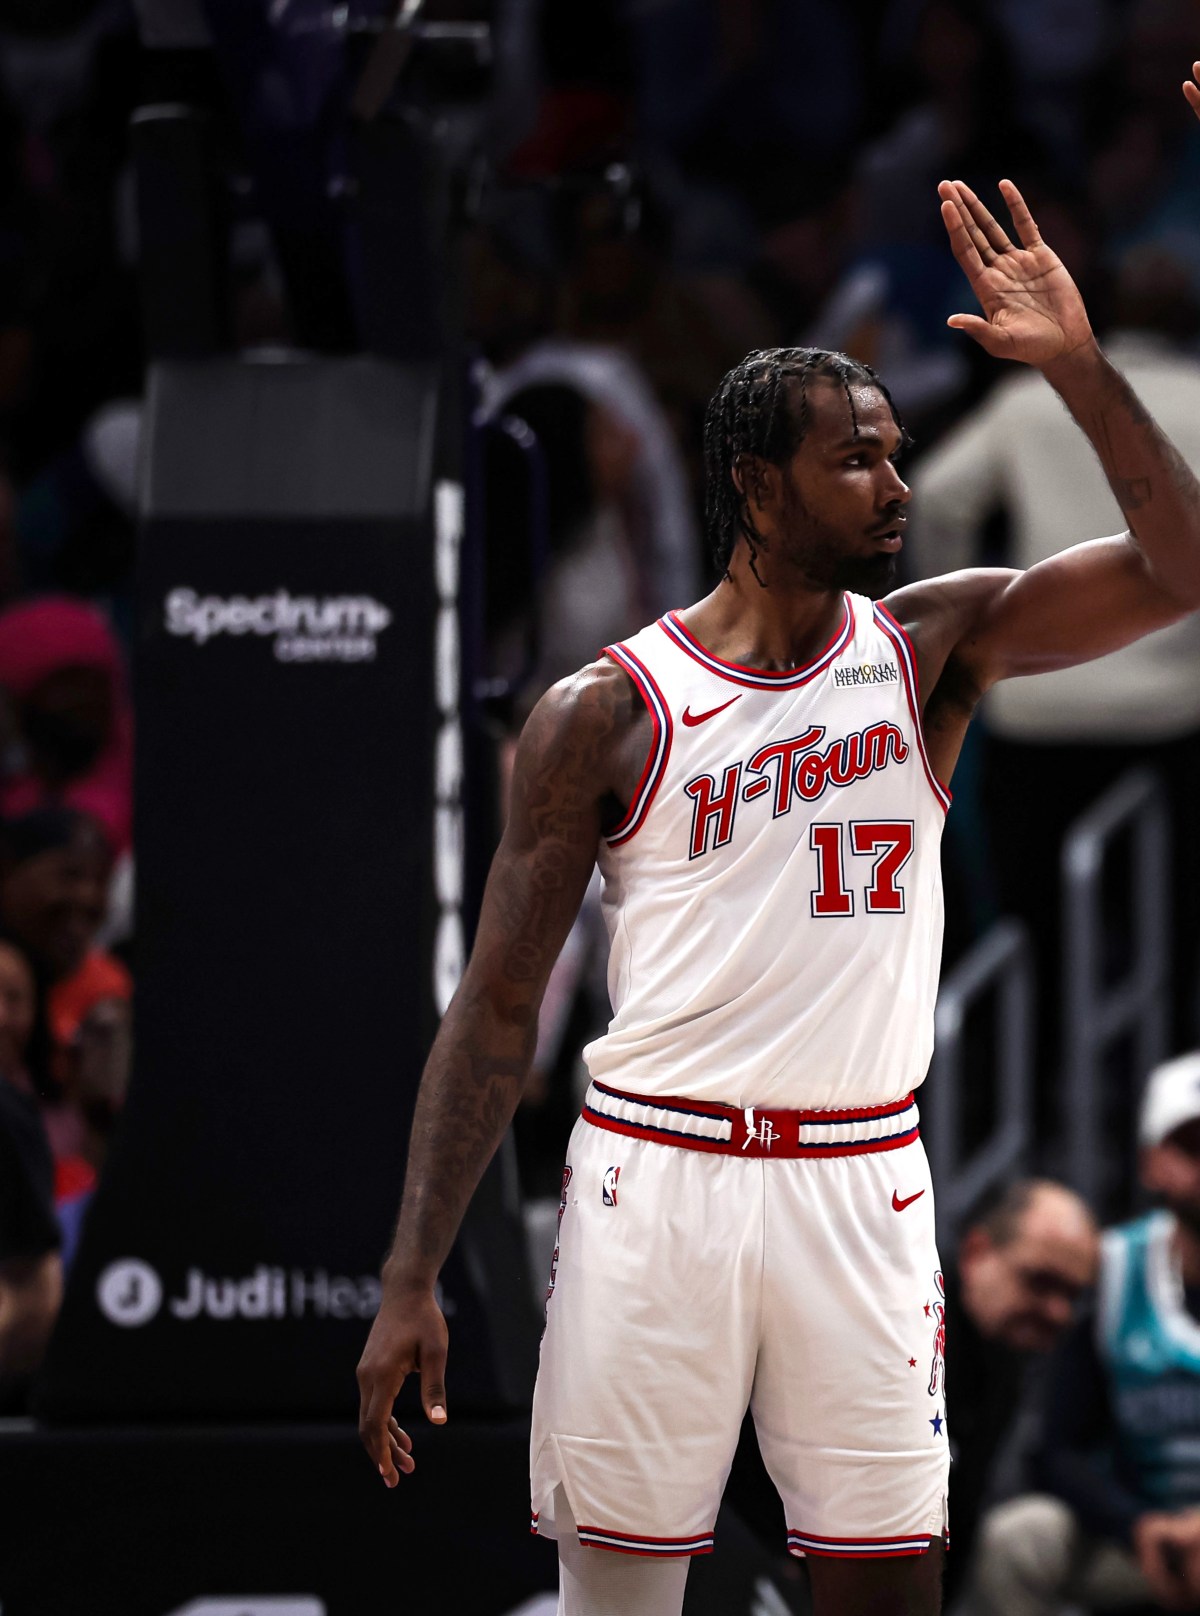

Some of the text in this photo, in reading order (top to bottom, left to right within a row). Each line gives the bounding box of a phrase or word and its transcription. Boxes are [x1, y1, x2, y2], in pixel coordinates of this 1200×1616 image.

[165, 587, 380, 646] Spectrum
[834, 662, 898, 679] MEMORIAL
[835, 670, 898, 687] HERMANN
[684, 720, 909, 861] H-Town
[810, 820, 914, 917] 17
[171, 1266, 287, 1319] Judi
